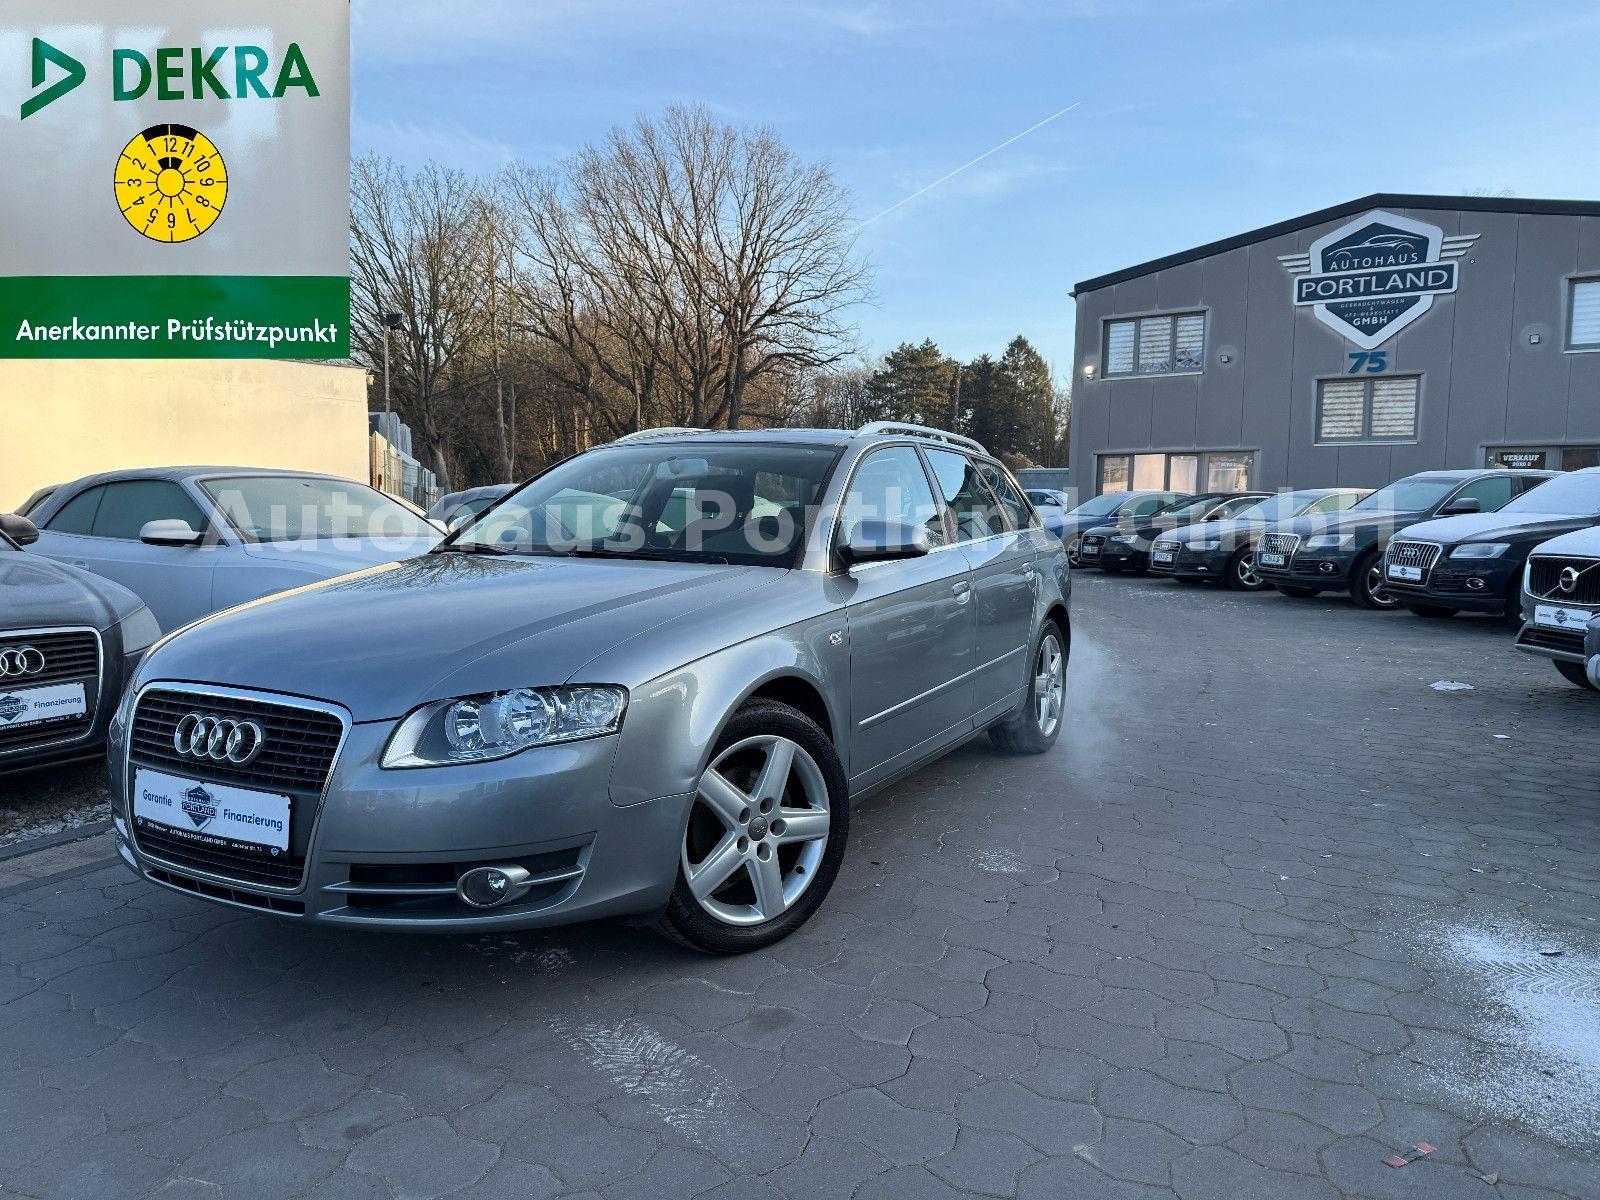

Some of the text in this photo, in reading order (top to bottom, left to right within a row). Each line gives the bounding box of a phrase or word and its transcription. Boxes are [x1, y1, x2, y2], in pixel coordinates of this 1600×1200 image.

[1330, 252, 1419, 271] AUTOHAUS
[1301, 270, 1448, 298] PORTLAND
[1353, 316, 1388, 326] GMBH
[1348, 351, 1387, 374] 75
[34, 697, 82, 708] Finanzierung
[143, 789, 172, 806] Garantie
[182, 802, 215, 815] PORTLAND
[223, 809, 283, 831] Finanzierung
